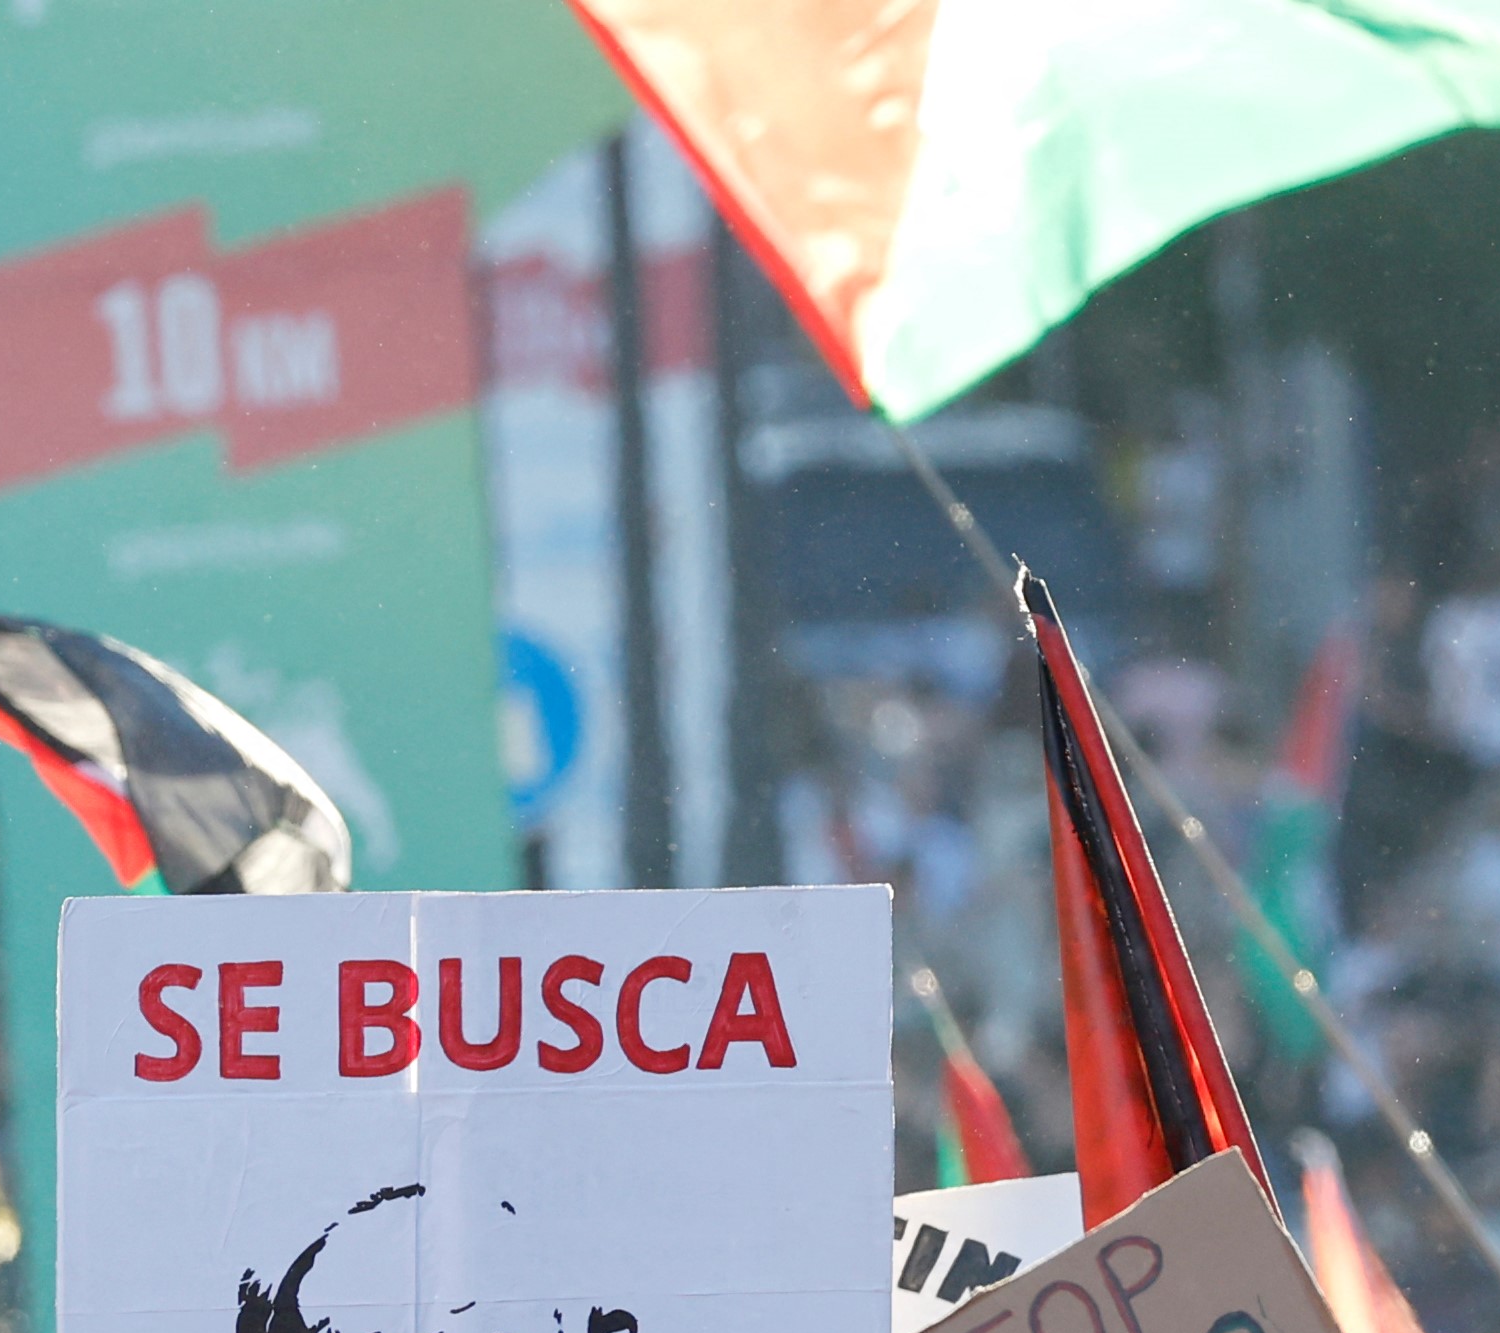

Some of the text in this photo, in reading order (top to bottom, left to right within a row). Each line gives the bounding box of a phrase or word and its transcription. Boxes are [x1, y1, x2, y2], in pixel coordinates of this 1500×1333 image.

[98, 275, 222, 420] 10
[134, 952, 797, 1082] SE BUSCA
